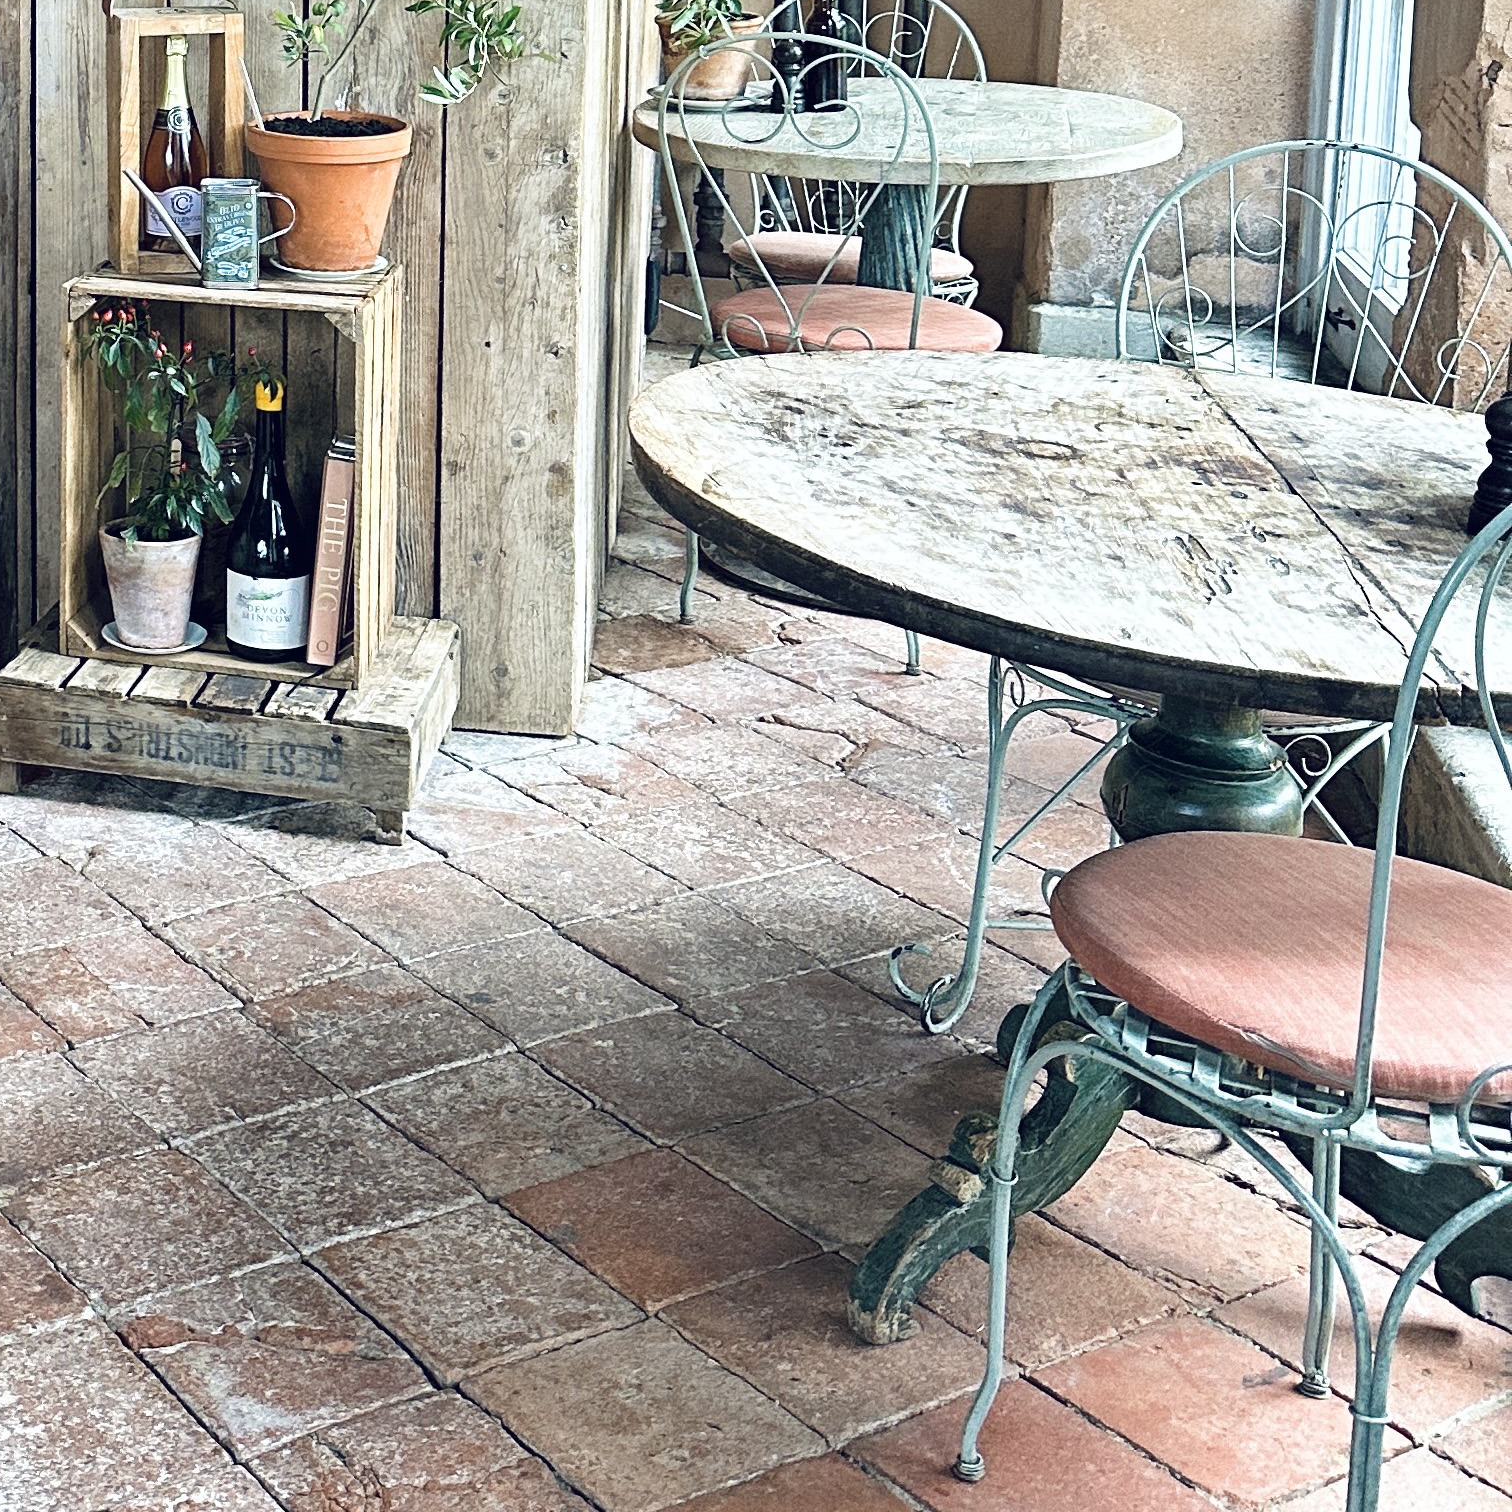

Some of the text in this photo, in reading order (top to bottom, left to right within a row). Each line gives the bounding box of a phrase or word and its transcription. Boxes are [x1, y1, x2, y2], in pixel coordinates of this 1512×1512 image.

[315, 498, 348, 613] THE PIG
[246, 603, 287, 615] DEVON
[241, 612, 294, 624] MINNOW
